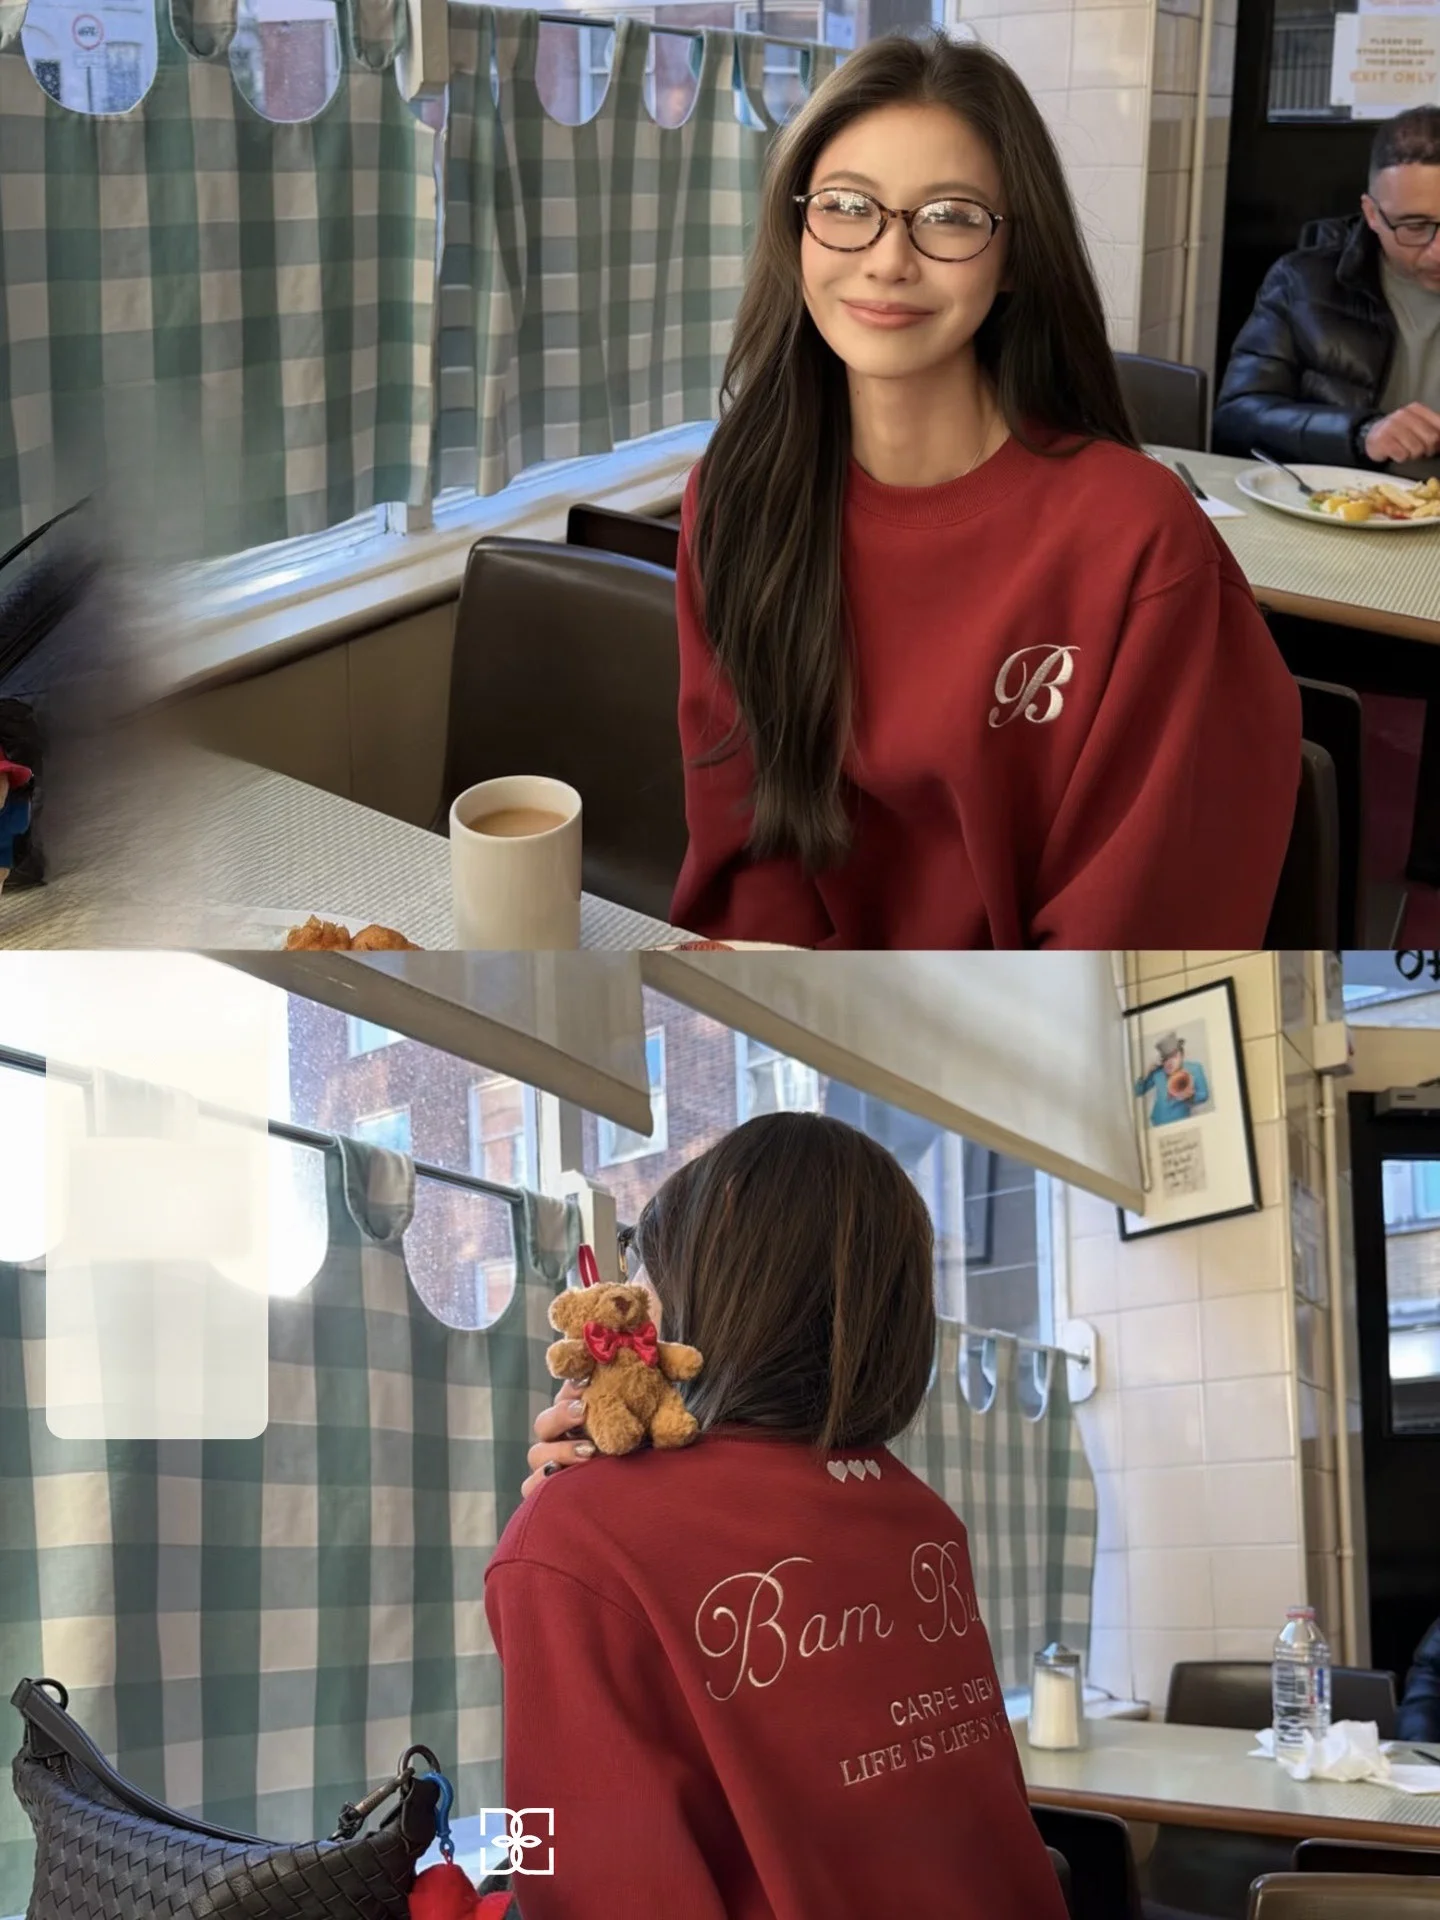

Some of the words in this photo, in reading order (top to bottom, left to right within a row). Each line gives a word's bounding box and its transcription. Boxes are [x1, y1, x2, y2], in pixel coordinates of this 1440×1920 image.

[1349, 70, 1387, 84] EXIT
[1393, 71, 1437, 85] ONLY
[988, 643, 1082, 729] B
[694, 1556, 895, 1701] Bam
[889, 1686, 960, 1727] CARPE
[838, 1743, 908, 1787] LIFE
[911, 1734, 936, 1763] IS
